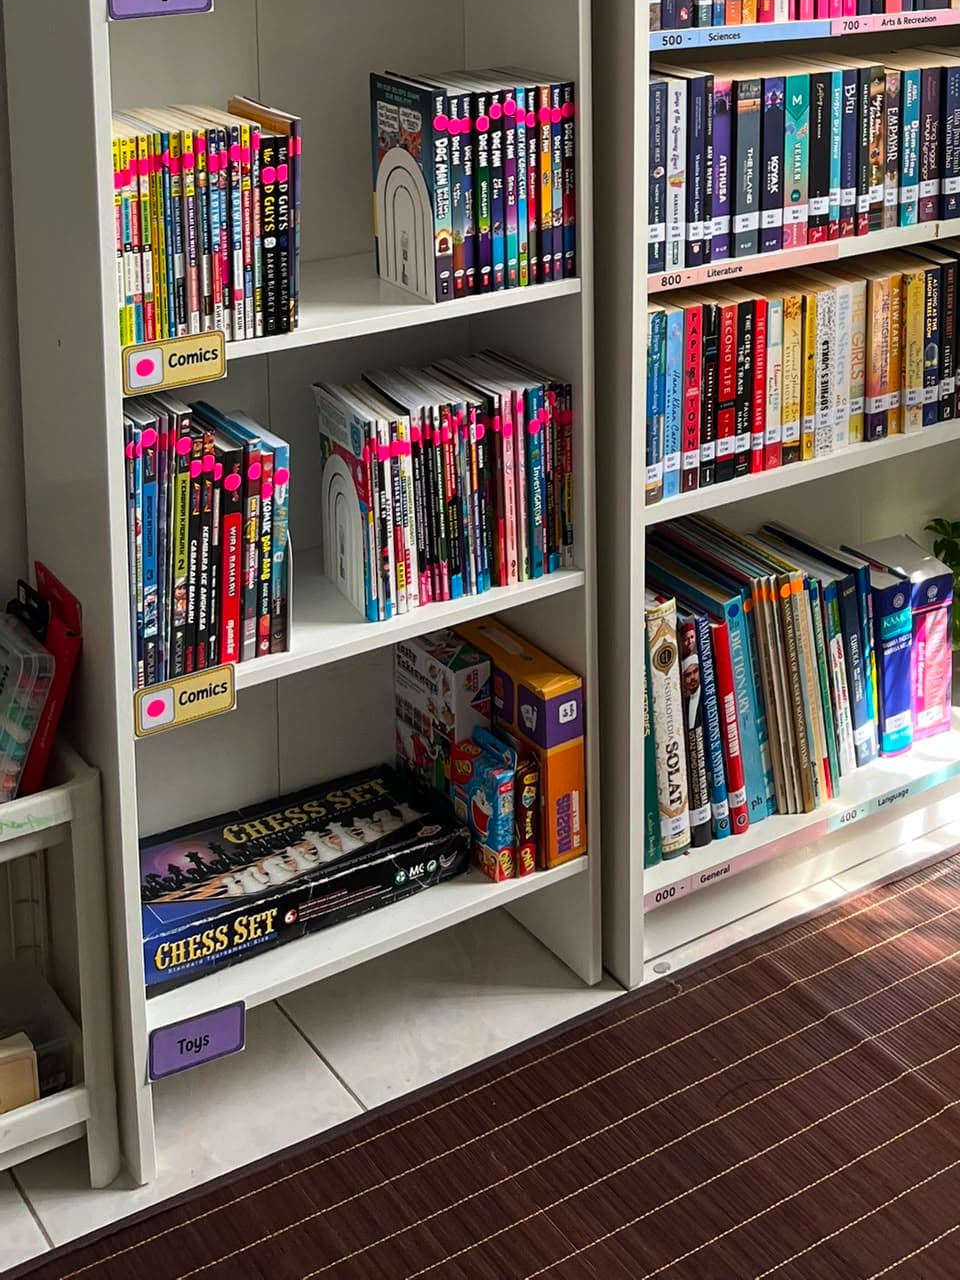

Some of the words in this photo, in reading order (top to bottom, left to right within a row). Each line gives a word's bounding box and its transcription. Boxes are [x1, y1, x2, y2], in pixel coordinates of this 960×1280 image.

[843, 20, 860, 31] 700
[881, 18, 896, 27] Arts
[897, 17, 903, 27] &
[904, 14, 937, 26] Recreation
[661, 34, 682, 47] 500
[708, 30, 741, 42] Sciences
[435, 137, 449, 162] DOG
[435, 163, 449, 185] MAN
[718, 155, 727, 204] AITHUSA
[745, 169, 754, 204] KLANG
[770, 155, 779, 194] KOYAK
[263, 197, 274, 232] GUYS
[278, 196, 288, 231] GUYS
[661, 274, 682, 287] 800
[707, 265, 744, 278] Literature
[838, 293, 849, 330] Blue
[891, 297, 900, 318] NEW
[744, 314, 752, 332] THE
[723, 311, 733, 363] SECOND
[744, 334, 752, 357] GIRL
[891, 322, 900, 357] EARTH
[168, 346, 219, 369] Comics
[736, 345, 745, 364] THE
[744, 357, 752, 370] ON
[836, 331, 848, 385] Sisters
[851, 331, 864, 380] GIRLS
[723, 367, 733, 395] LIFE
[736, 365, 745, 395] TRAIN
[742, 401, 750, 428] PAULA
[670, 425, 679, 454] Carrie
[229, 525, 237, 552] WIRA
[785, 625, 796, 661] TREASURY
[702, 658, 712, 682] BOOK
[730, 629, 751, 713] DICTIONARY
[179, 681, 228, 706] Comics
[723, 692, 737, 717] WORLD
[726, 718, 740, 757] HISTORY
[665, 741, 683, 807] SOLAT
[877, 787, 910, 808] Language
[223, 800, 327, 845] CHESS
[325, 777, 387, 804] SET
[840, 809, 858, 824] 400
[700, 864, 731, 884] General
[655, 886, 676, 903] 000
[154, 926, 230, 972] CHESS
[233, 907, 279, 945] SET
[176, 1032, 211, 1056] Toys
